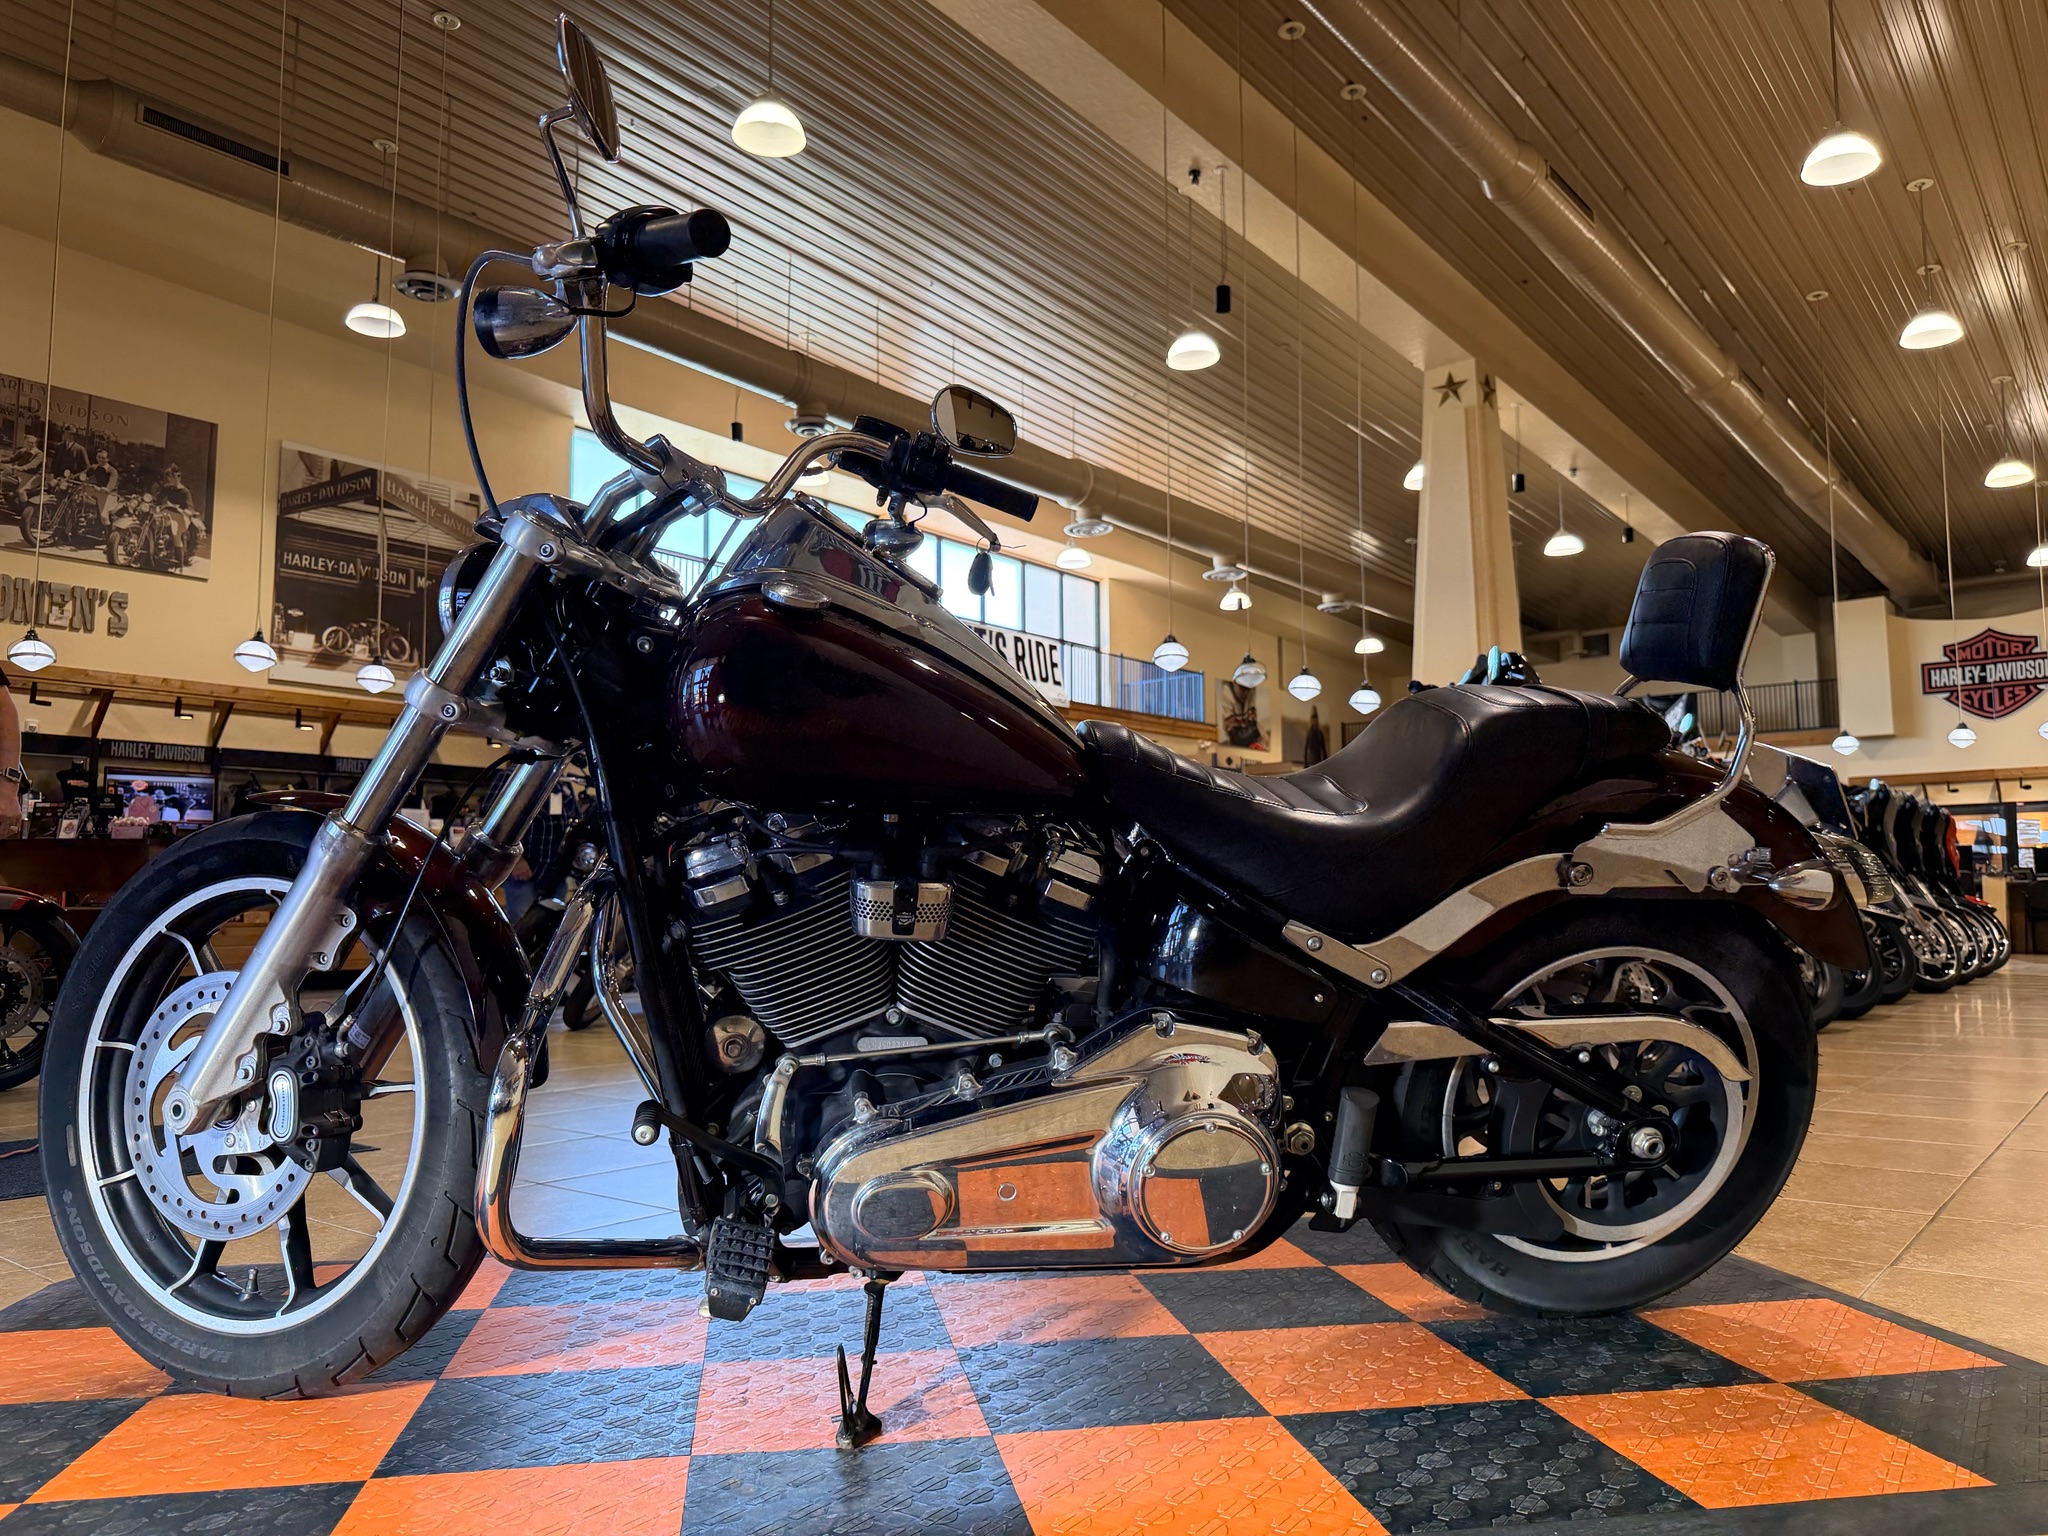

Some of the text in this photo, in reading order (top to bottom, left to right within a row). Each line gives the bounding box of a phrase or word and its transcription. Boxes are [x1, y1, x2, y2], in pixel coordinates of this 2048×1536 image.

[1014, 635, 1062, 687] RIDE
[1958, 638, 2025, 661] MOTOR
[1930, 658, 2048, 688] HARLEY-DAVIDSO
[1960, 685, 2027, 713] CYCLES
[111, 740, 206, 763] HARLEY-DAVIDSON
